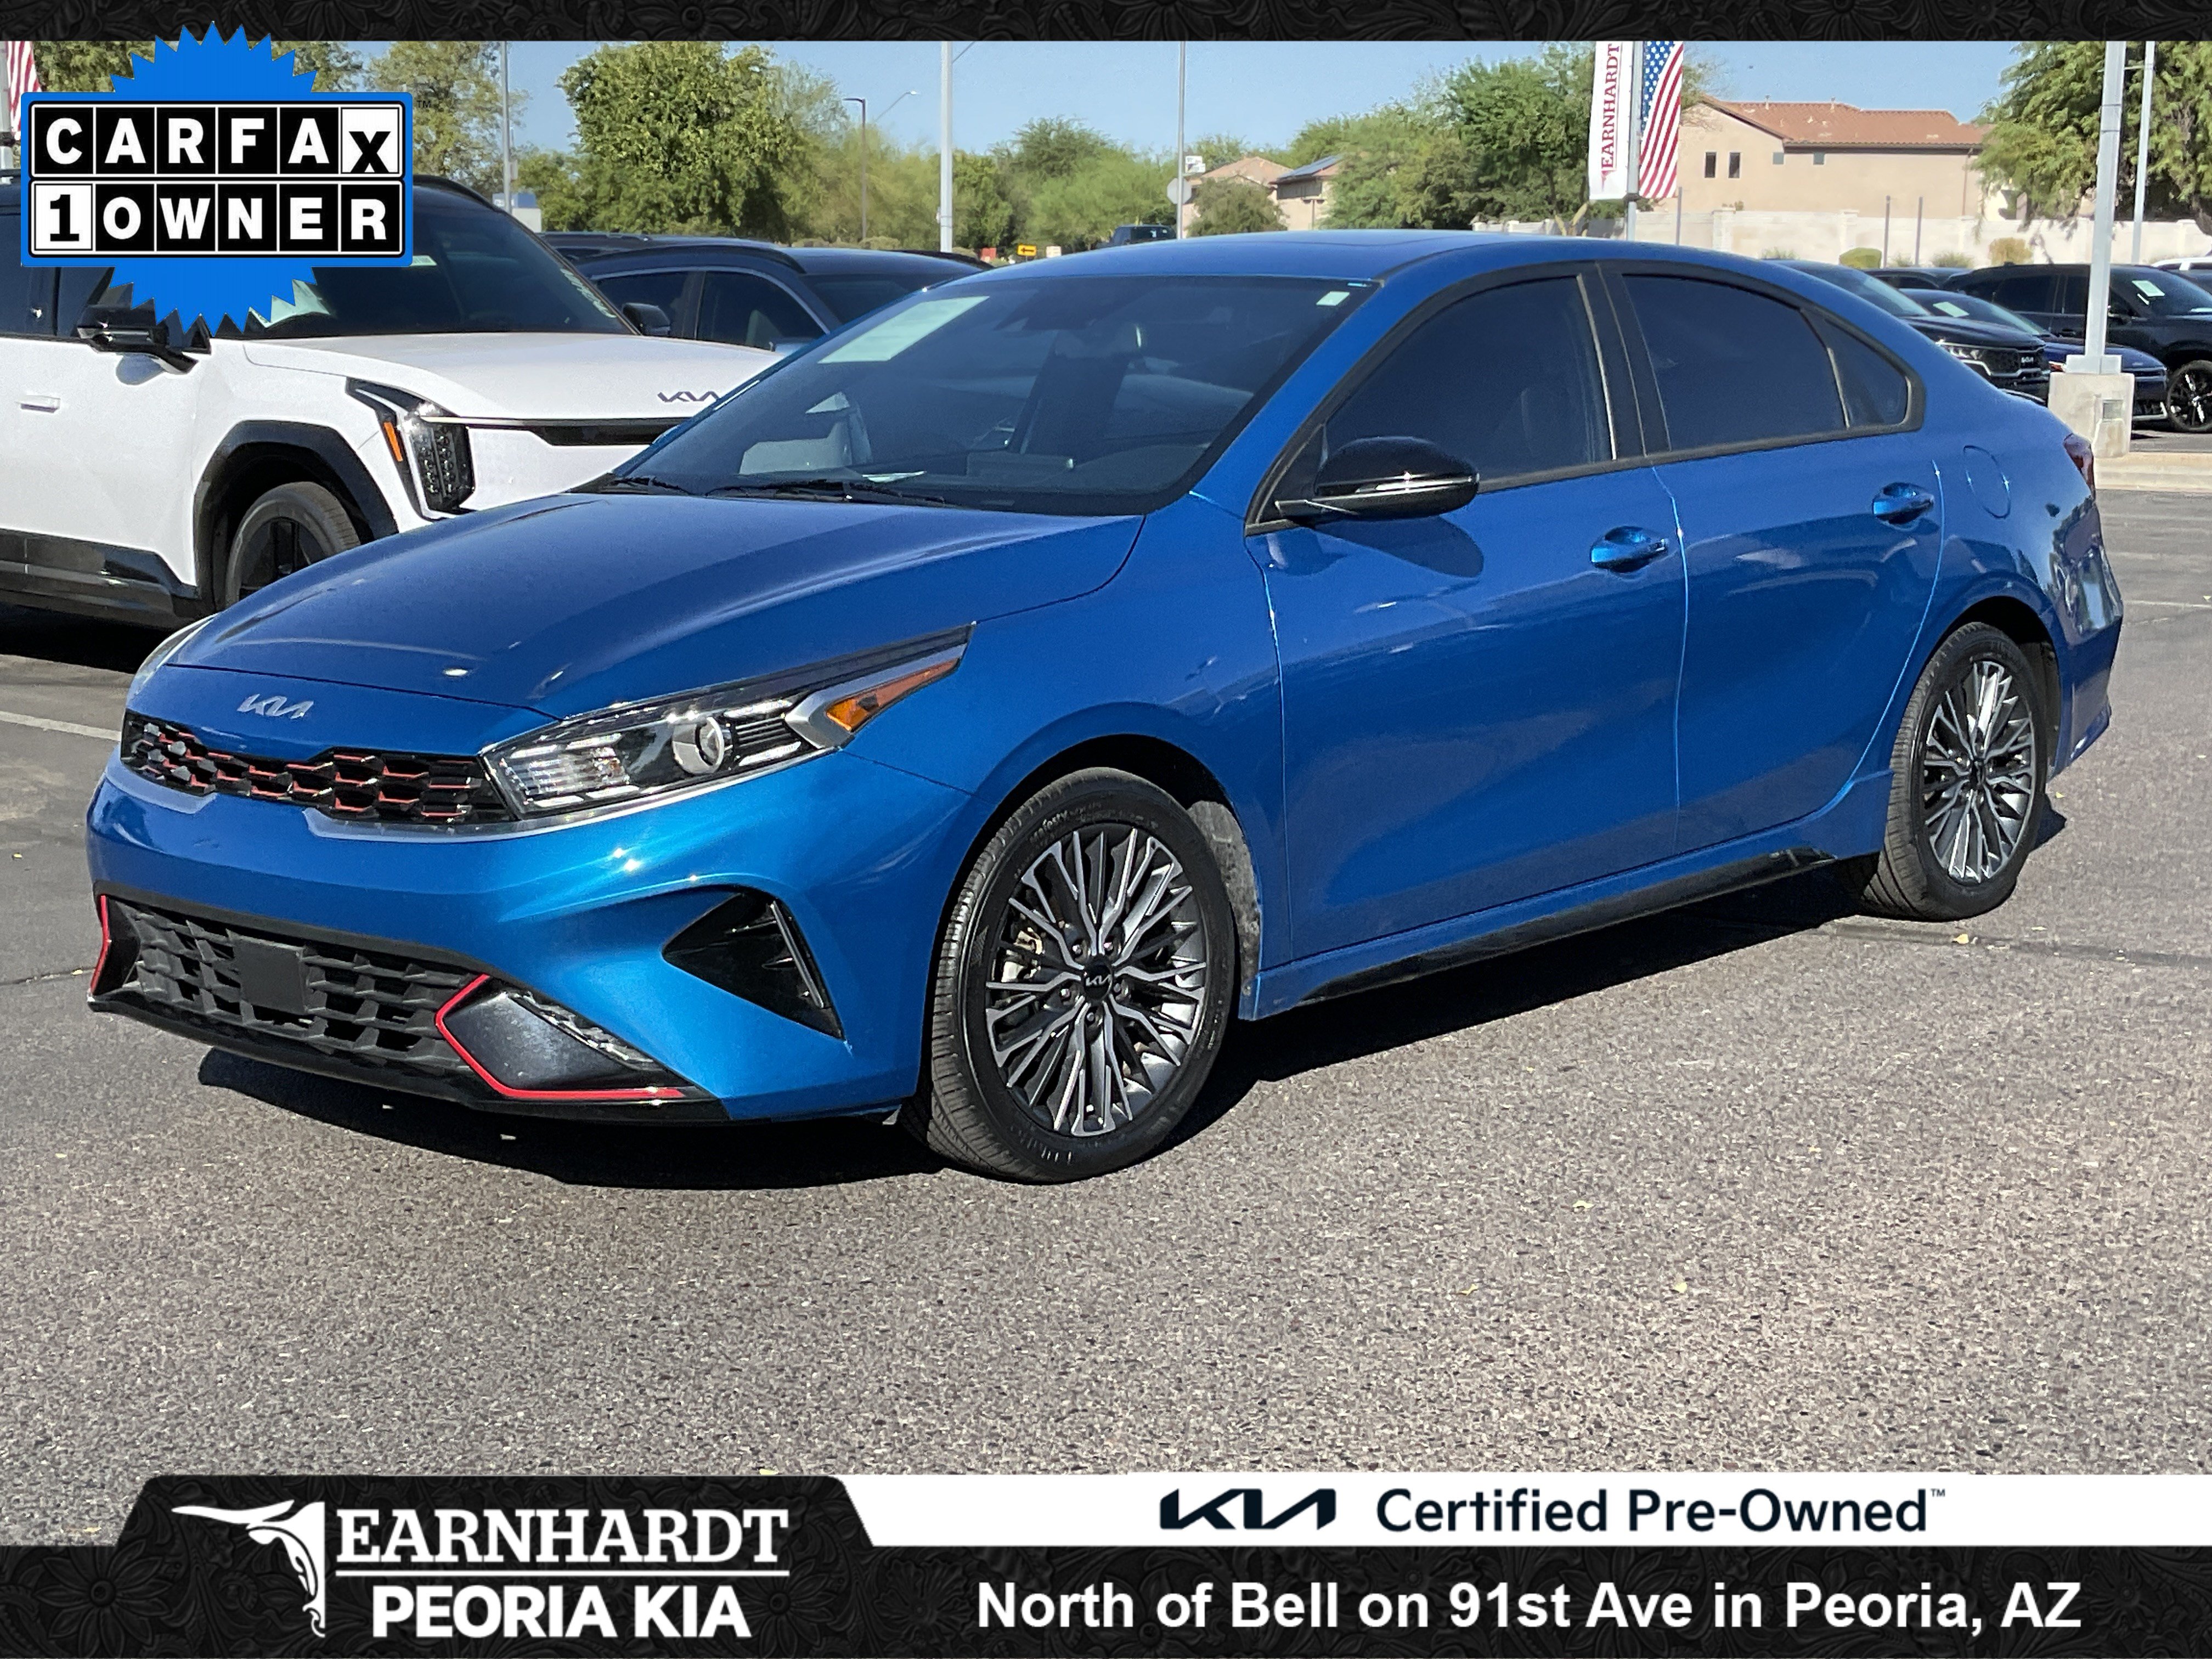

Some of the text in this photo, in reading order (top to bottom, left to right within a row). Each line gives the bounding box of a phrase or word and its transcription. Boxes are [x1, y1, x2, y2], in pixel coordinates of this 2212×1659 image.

[1601, 43, 1621, 169] EARNHARDT
[236, 693, 314, 719] KIA
[1086, 974, 1112, 986] KIA
